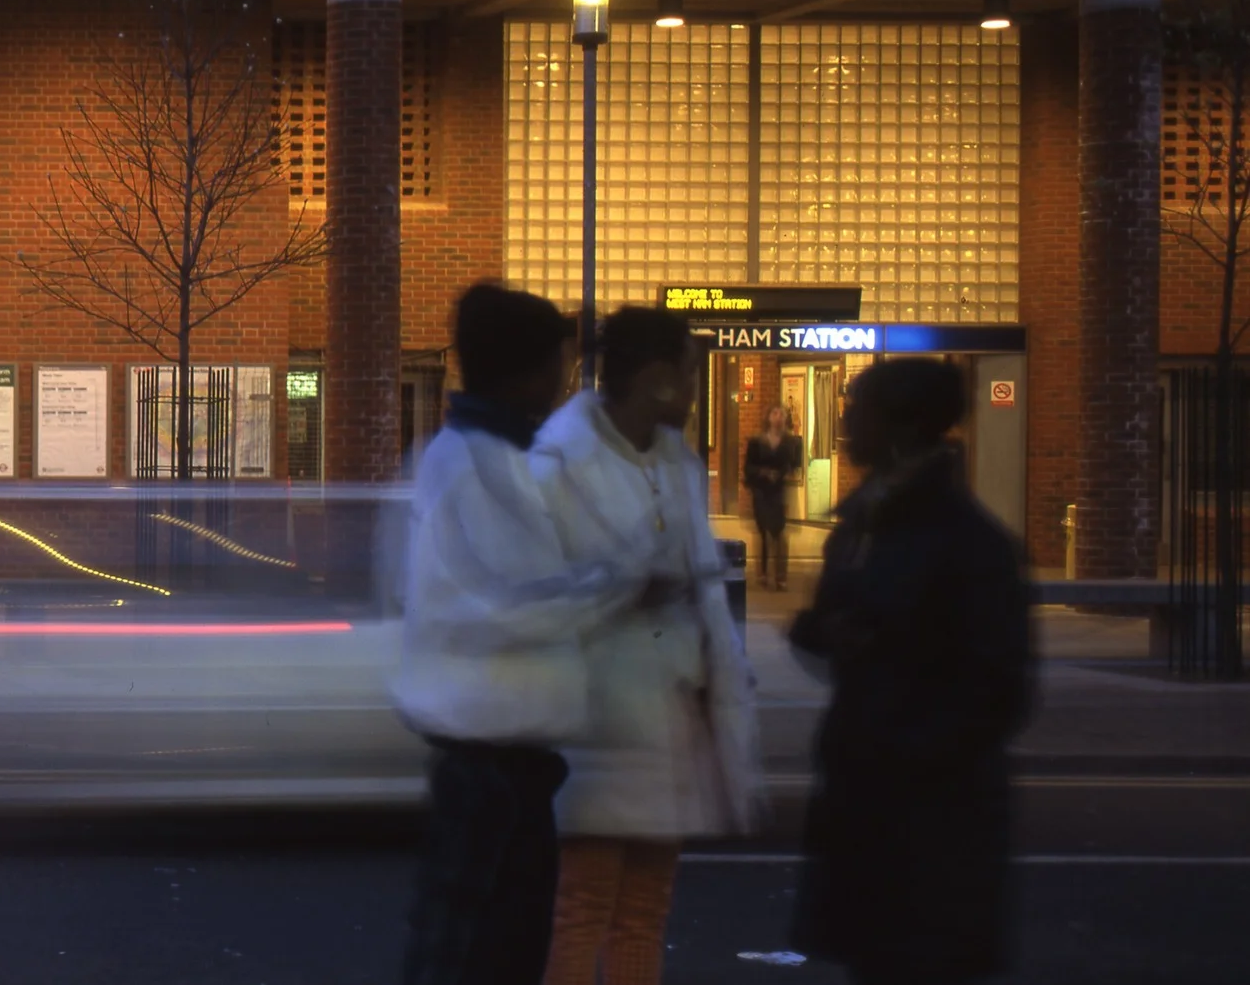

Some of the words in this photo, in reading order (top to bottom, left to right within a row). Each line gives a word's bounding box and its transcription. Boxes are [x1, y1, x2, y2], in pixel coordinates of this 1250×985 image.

[666, 288, 708, 299] WELCOME
[709, 288, 724, 299] TO
[666, 298, 692, 309] WEST
[713, 298, 753, 310] STATION
[717, 328, 772, 347] HAM
[778, 327, 876, 350] STATION
